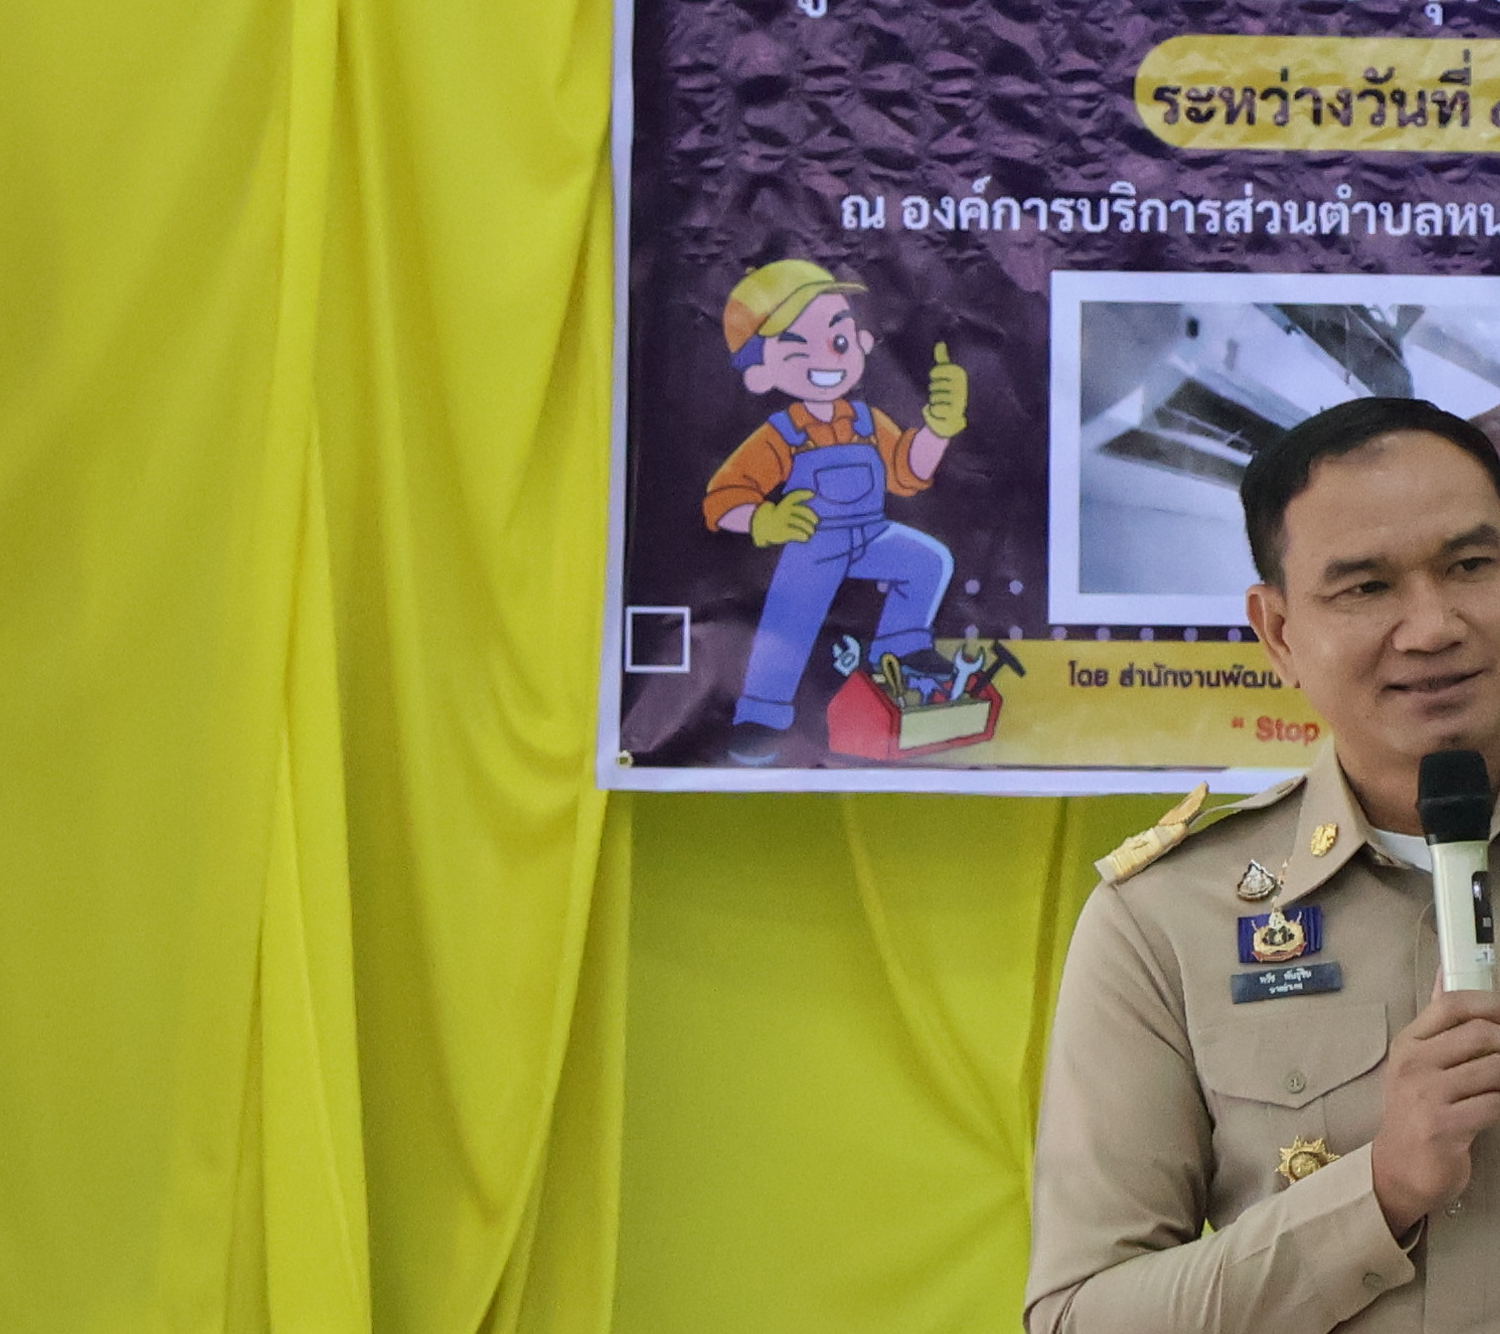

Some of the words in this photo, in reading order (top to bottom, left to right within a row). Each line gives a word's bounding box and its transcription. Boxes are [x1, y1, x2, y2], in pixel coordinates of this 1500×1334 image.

[1151, 50, 1472, 130] ระหว่างวันที่
[841, 195, 886, 230] ณ
[1067, 659, 1110, 688] โดย
[1118, 662, 1283, 690] สำนักงานพัฒน
[1255, 715, 1322, 746] Stop
